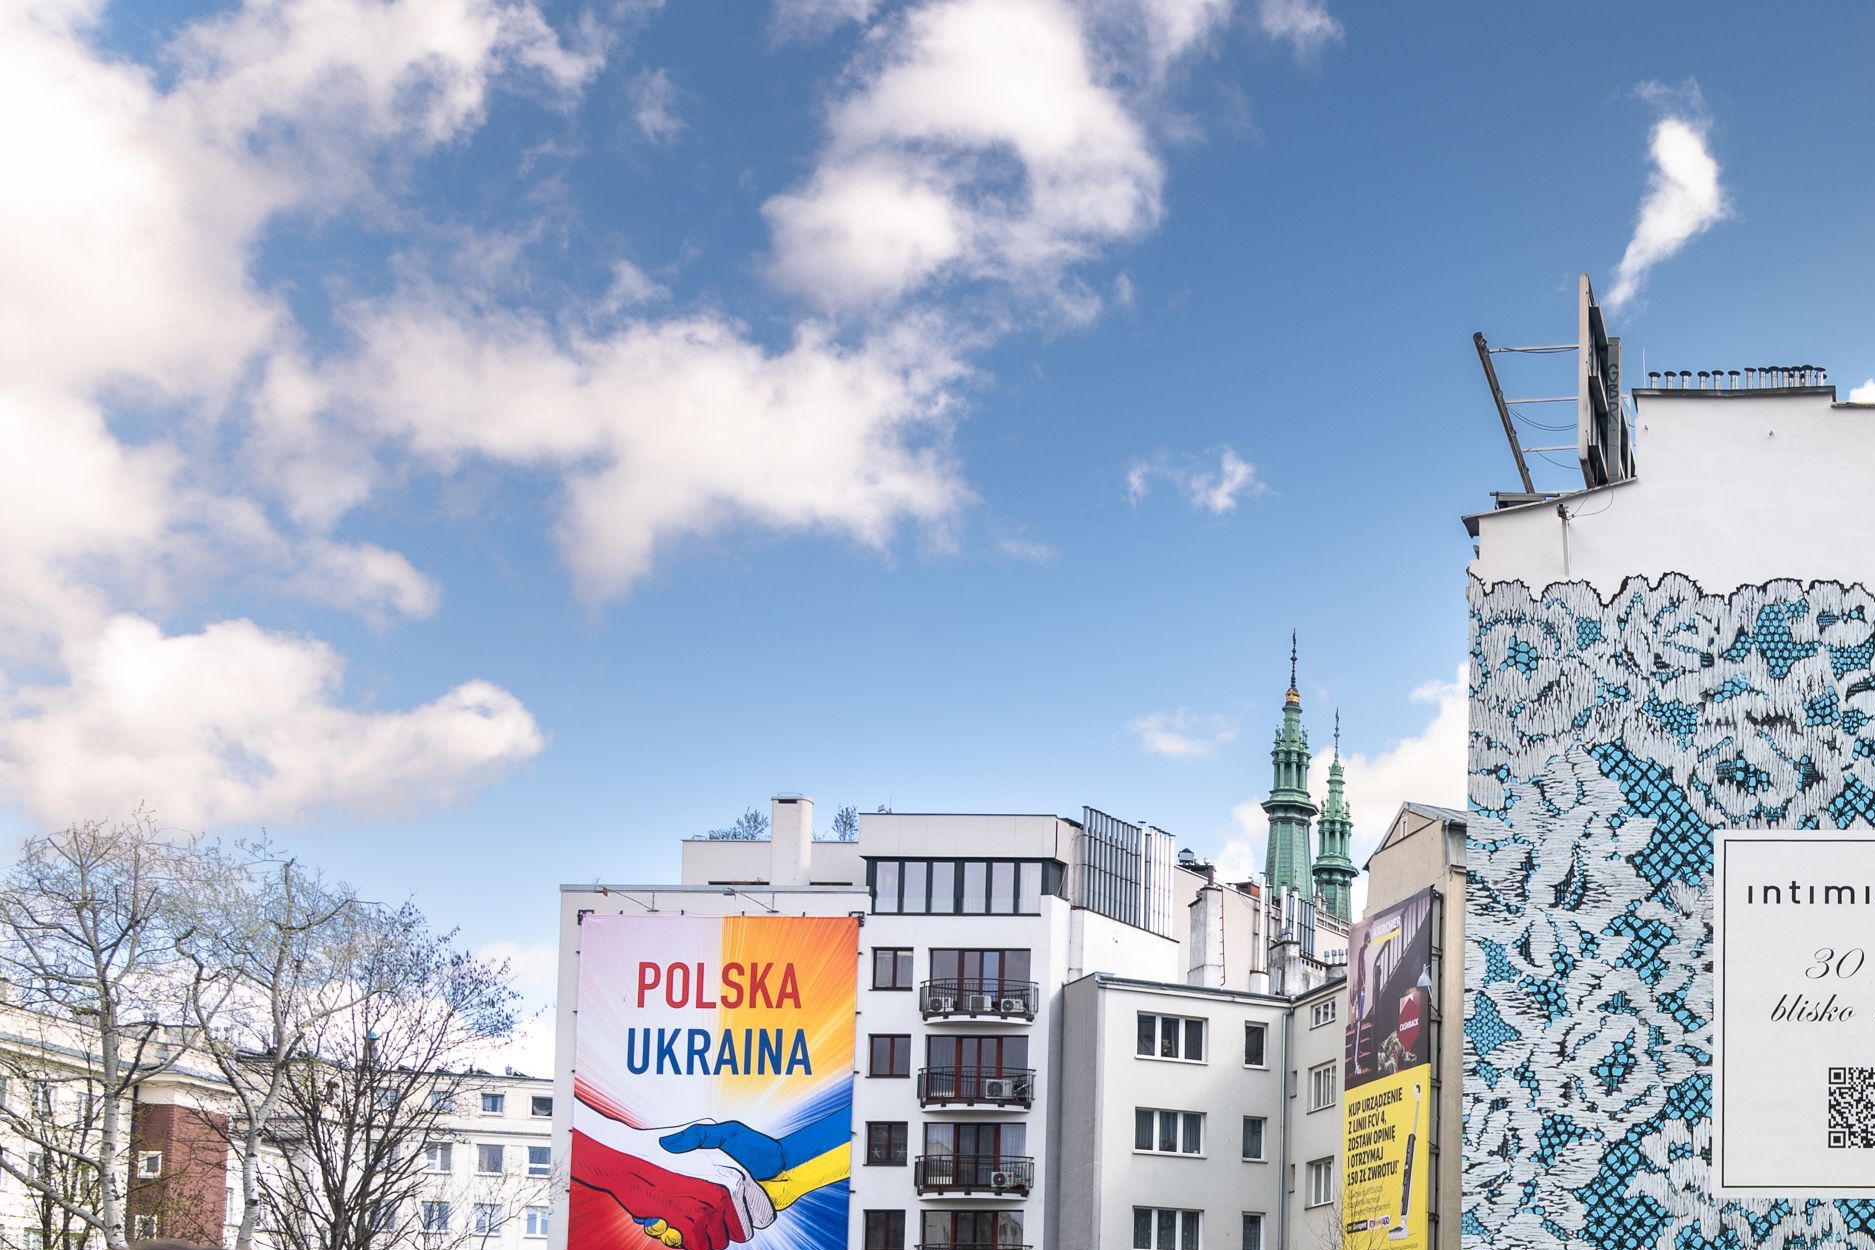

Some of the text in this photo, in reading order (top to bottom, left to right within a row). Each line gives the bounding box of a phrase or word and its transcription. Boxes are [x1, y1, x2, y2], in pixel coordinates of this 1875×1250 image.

[1804, 947, 1865, 980] 30
[636, 961, 802, 1009] POLSKA
[1770, 994, 1857, 1022] blisko
[626, 1028, 813, 1075] UKRAINA
[1348, 1087, 1403, 1118] KUP URZĄDZENIE
[1348, 1125, 1395, 1152] ZOSTAW OPINIĘ
[1351, 1146, 1384, 1169] OTRZYMAJ
[1347, 1171, 1358, 1187] 150
